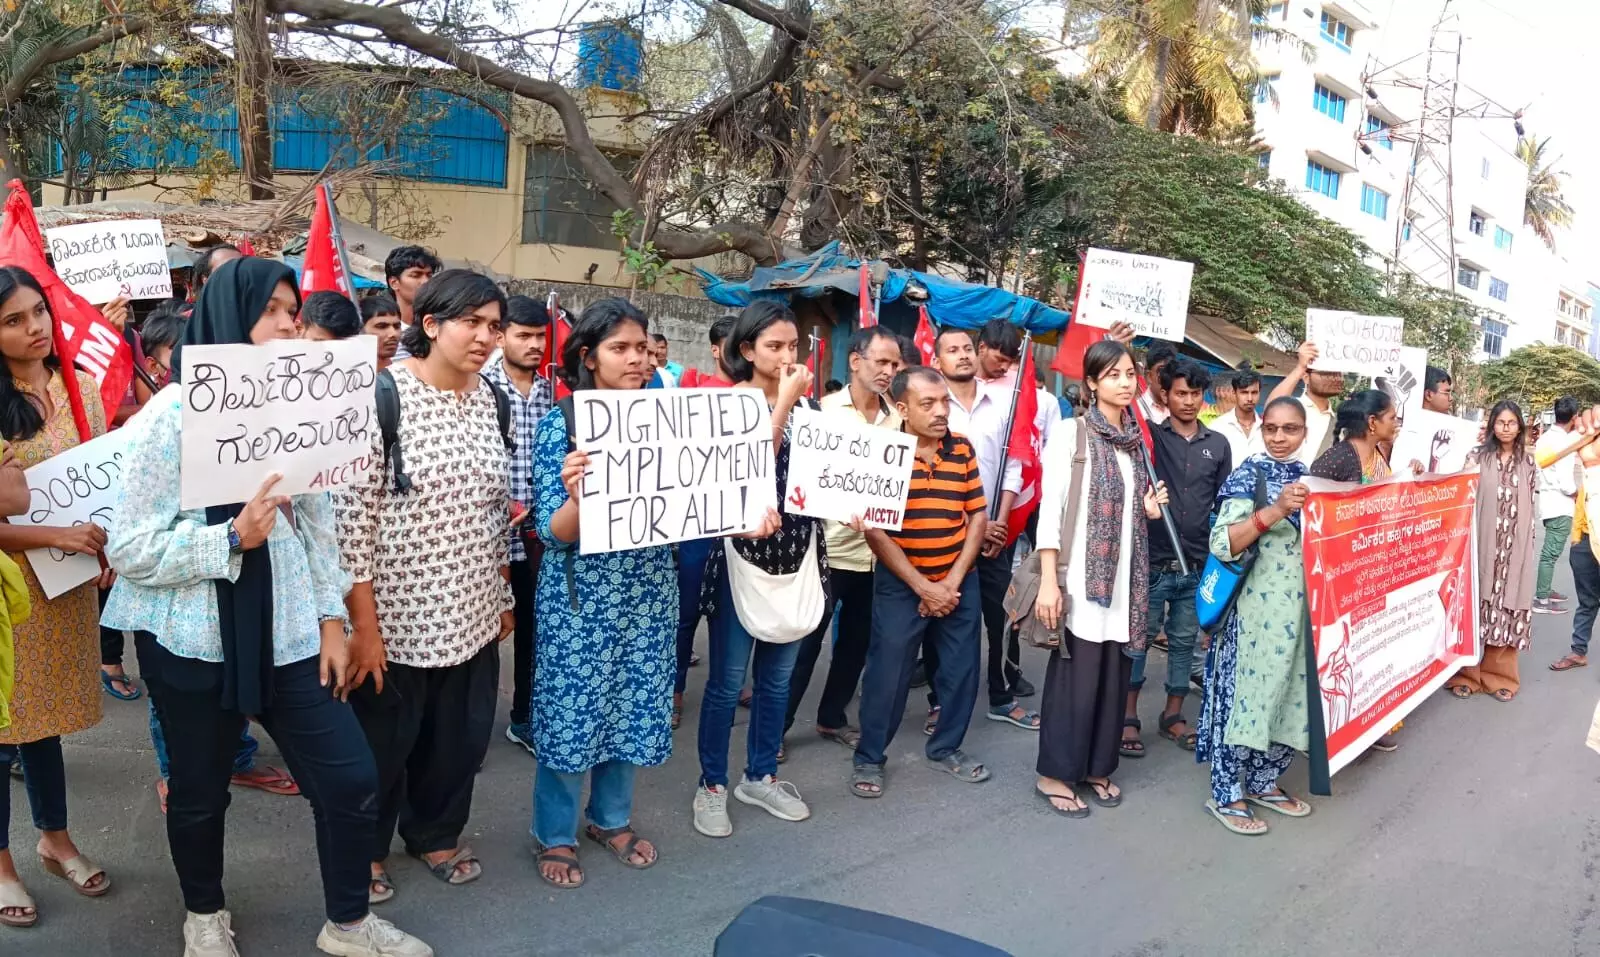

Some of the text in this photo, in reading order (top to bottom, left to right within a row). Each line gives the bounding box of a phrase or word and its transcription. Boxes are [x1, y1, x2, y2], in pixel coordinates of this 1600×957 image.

[140, 284, 172, 297] AICCTU
[584, 393, 760, 444] DIGNIFIED
[309, 454, 371, 488] AICCTU
[582, 439, 773, 498] EMPLOYMENT
[883, 444, 909, 467] OT
[608, 486, 748, 550] FOR ALL!
[863, 507, 900, 525] AICCTU
